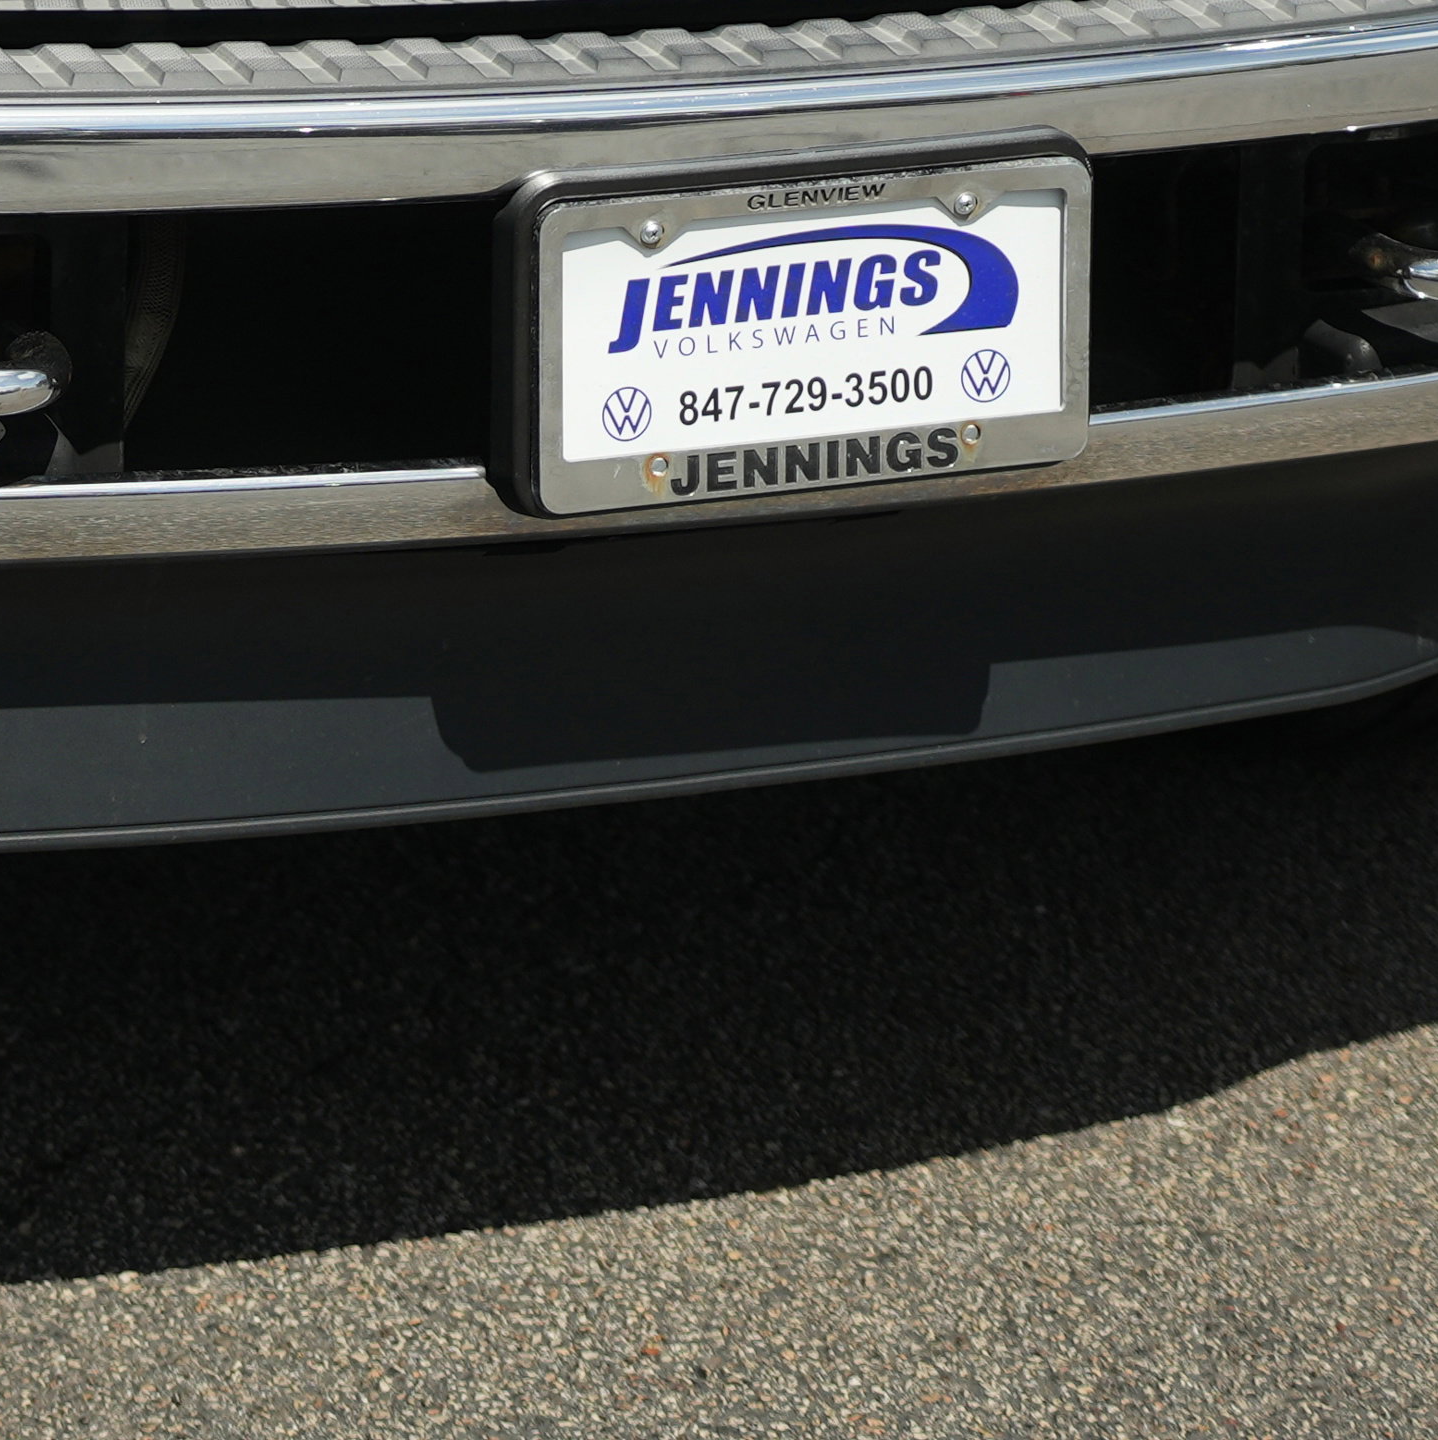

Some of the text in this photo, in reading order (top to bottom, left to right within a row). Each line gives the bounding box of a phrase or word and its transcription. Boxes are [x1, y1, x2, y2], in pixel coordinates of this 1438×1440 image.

[747, 183, 886, 211] GLENVIEW
[607, 249, 942, 354] JENNINGS
[653, 316, 897, 359] VOLKSWAGEN
[678, 365, 934, 426] 847-729-3500
[671, 427, 960, 497] JENNINGS
